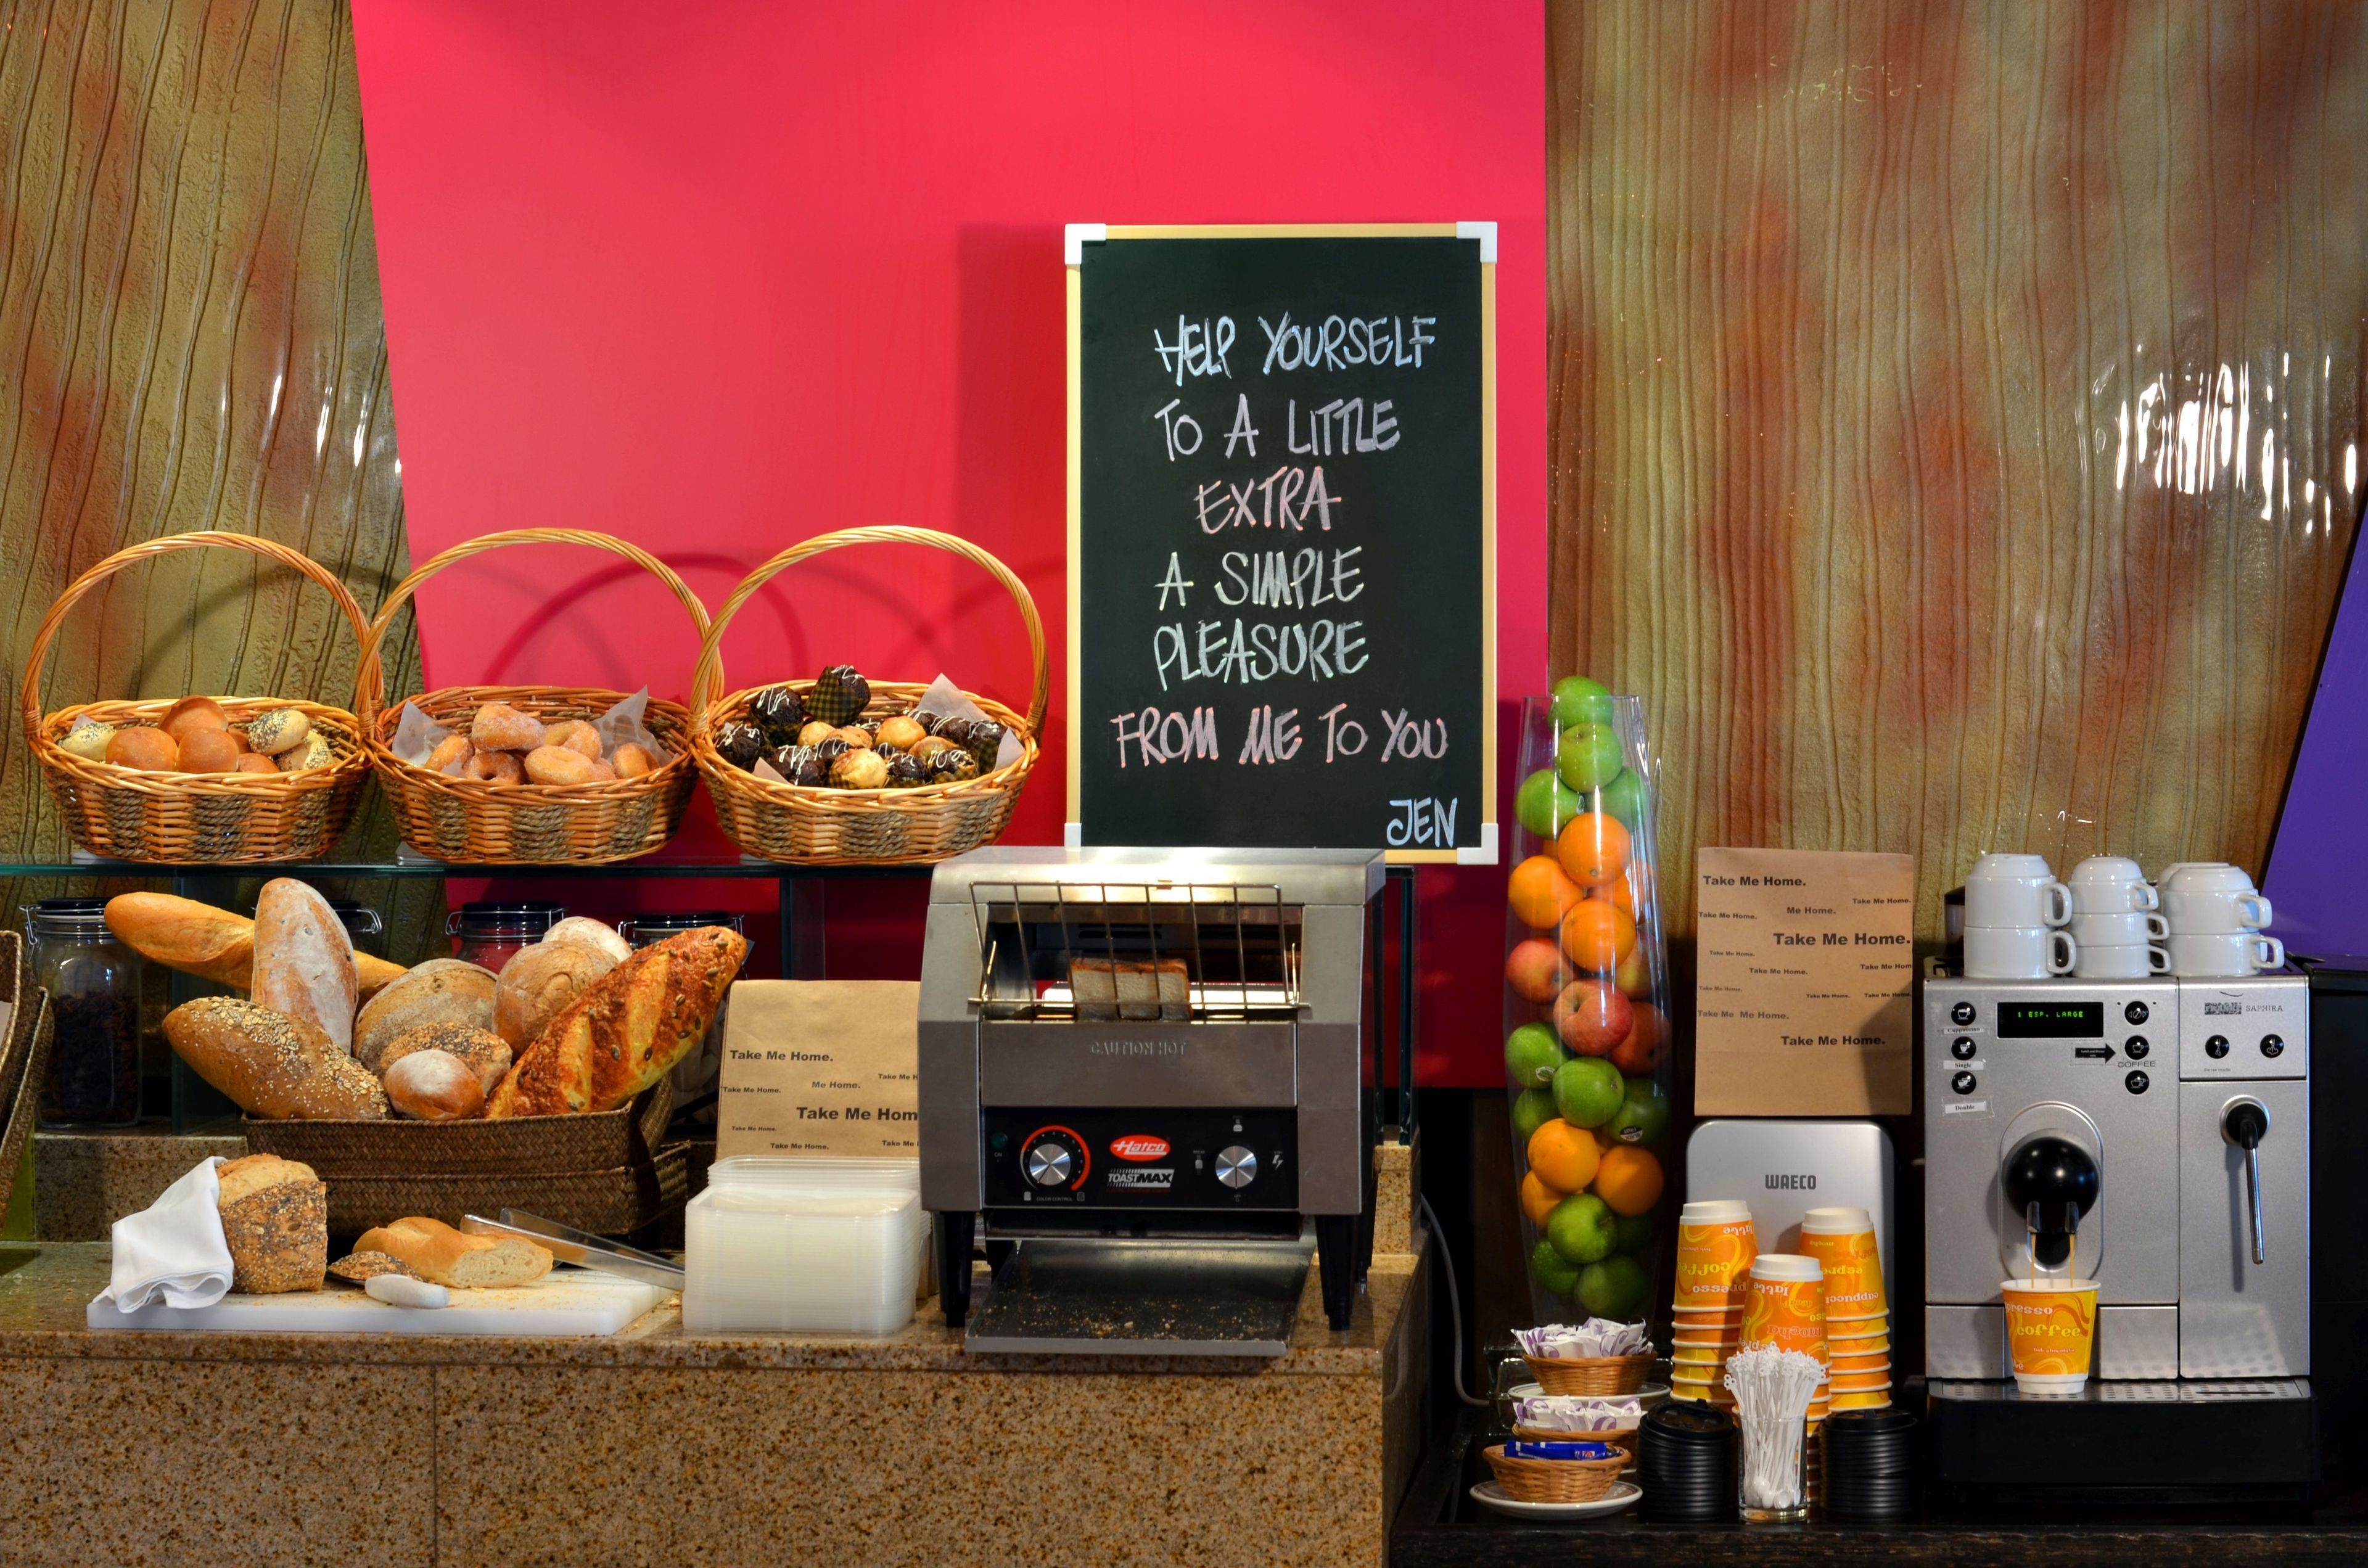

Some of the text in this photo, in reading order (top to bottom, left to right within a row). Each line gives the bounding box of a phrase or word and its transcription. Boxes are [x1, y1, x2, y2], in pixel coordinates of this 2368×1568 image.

[1154, 312, 1436, 386] HELP YOURSELF
[1154, 393, 1400, 461] TO A LITTLE
[1194, 466, 1342, 534] EXTRA
[1154, 546, 1364, 610] A SIMPLE
[1154, 618, 1369, 691] PLEASURE
[1111, 702, 1449, 768] FROM ME TO YOU
[1387, 797, 1457, 848] JEN
[1703, 876, 1806, 886] Take Me Home.
[1773, 933, 1910, 945] Take Me Home.
[1781, 1036, 1885, 1045] Take Me Home.
[1092, 1041, 1186, 1055] CAUTION HOT
[730, 1050, 833, 1061] Take Me Home.
[796, 1107, 839, 1120] Take
[845, 1107, 871, 1120] Me
[1112, 1140, 1167, 1155] Hatco
[1108, 1173, 1172, 1183] TOASTMAX
[1765, 1174, 1817, 1190] WAECO
[1723, 1225, 1753, 1236] latte
[1753, 1282, 1789, 1296] latte
[2004, 1302, 2053, 1315] presso
[1767, 1324, 1822, 1340] mocha
[2016, 1324, 2081, 1337] coffee
